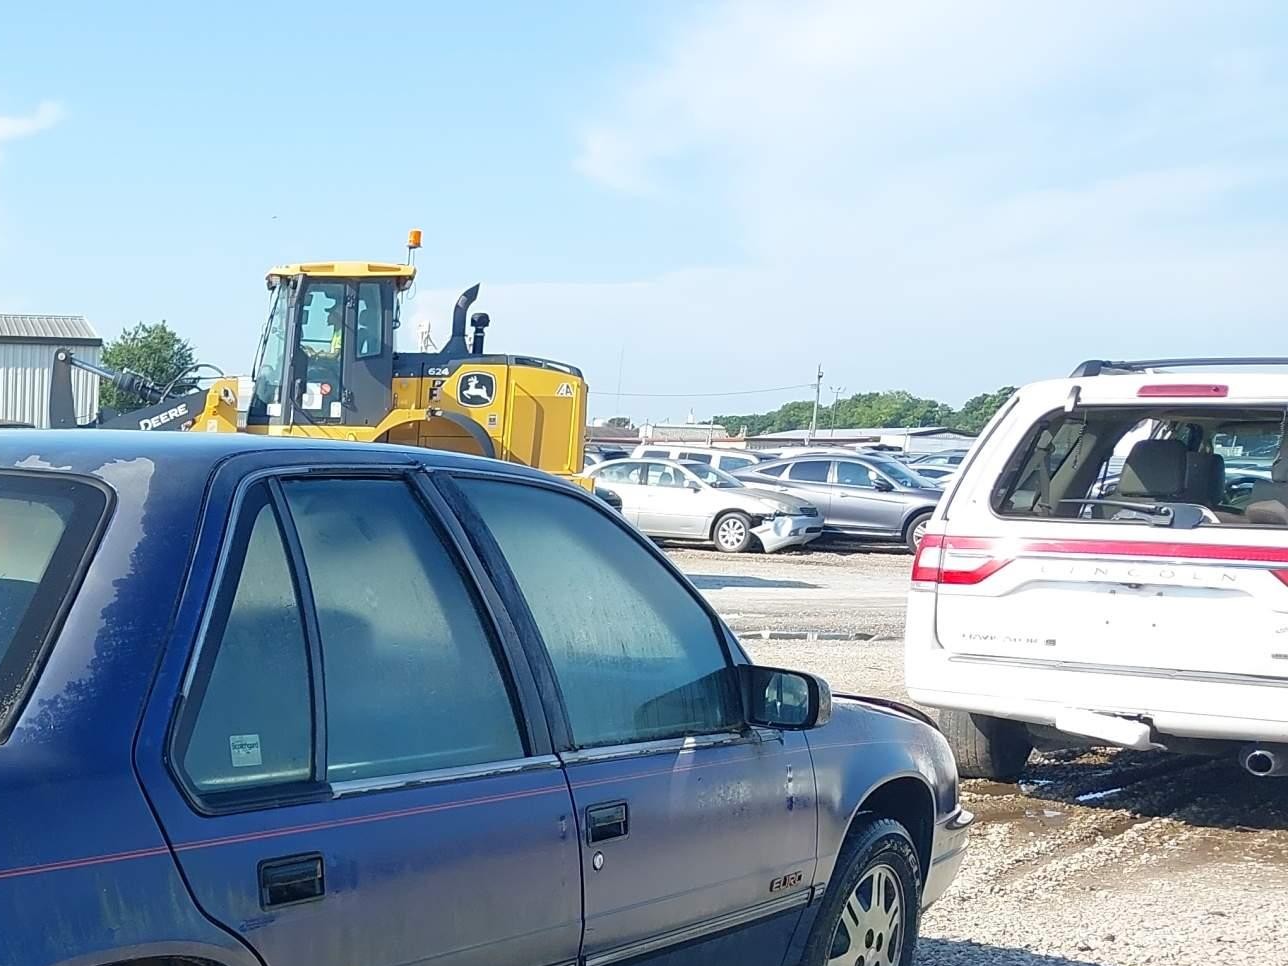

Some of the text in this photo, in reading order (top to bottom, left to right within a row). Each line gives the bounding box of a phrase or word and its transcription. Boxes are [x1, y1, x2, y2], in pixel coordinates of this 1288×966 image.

[428, 367, 449, 376] 624
[139, 403, 189, 431] DEERE
[1040, 565, 1237, 583] LINCOLN
